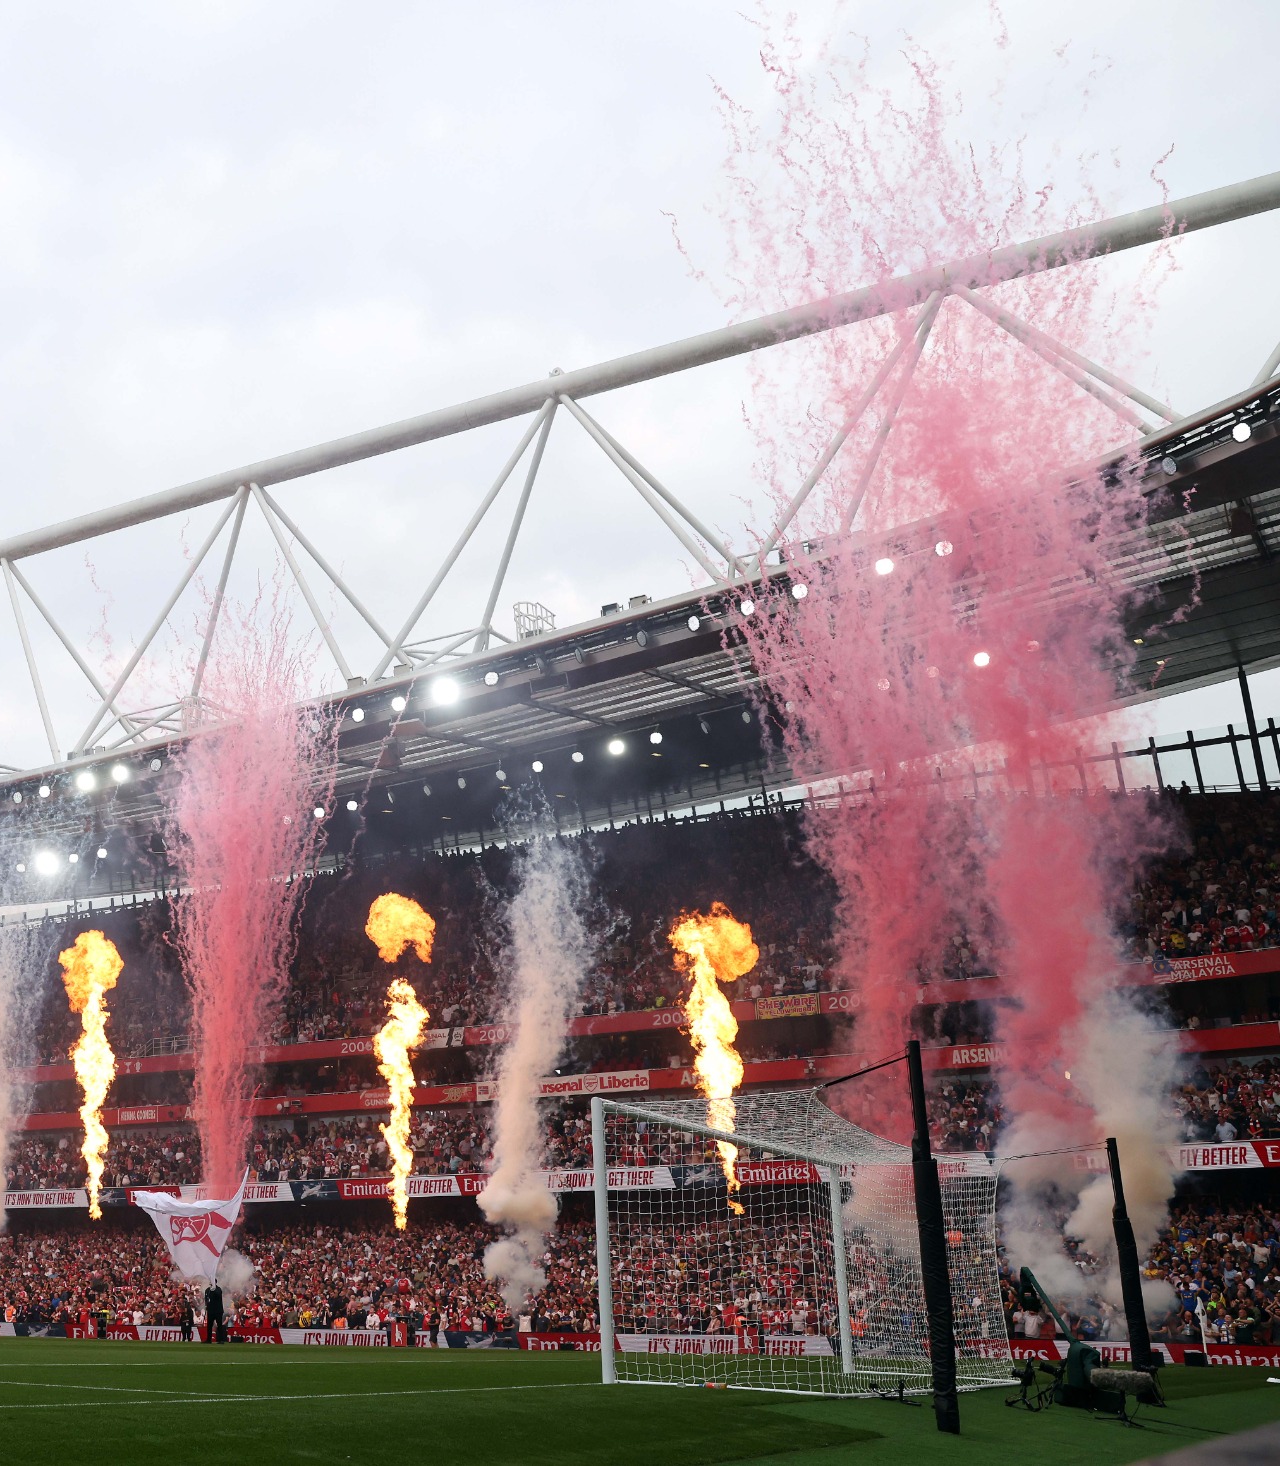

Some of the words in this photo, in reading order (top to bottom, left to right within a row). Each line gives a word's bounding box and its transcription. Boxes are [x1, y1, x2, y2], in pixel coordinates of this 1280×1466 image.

[1173, 955, 1231, 970] ARSENAL
[1170, 965, 1236, 981] MALAYSIA
[599, 1073, 648, 1089] Liberia
[1180, 1148, 1199, 1167] FLY
[1202, 1146, 1248, 1167] BETTER
[547, 1173, 565, 1189] IT'S
[566, 1172, 589, 1188] HOW
[608, 1171, 626, 1186] GET
[626, 1170, 655, 1186] THERE
[737, 1163, 811, 1182] Emirates
[255, 1185, 278, 1199] THERE
[408, 1179, 423, 1194] FLY
[423, 1179, 453, 1194] BETTER
[4, 1193, 15, 1206] IT'S
[15, 1192, 32, 1205] HOW
[32, 1192, 44, 1205] YOU
[44, 1192, 57, 1205] GET
[57, 1191, 76, 1204] THERE
[303, 1332, 322, 1346] IT'S
[324, 1332, 350, 1347] HOW
[373, 1333, 387, 1347] GE
[648, 1337, 670, 1353] IT'S
[675, 1337, 705, 1354] HOW
[764, 1339, 807, 1356] THERE
